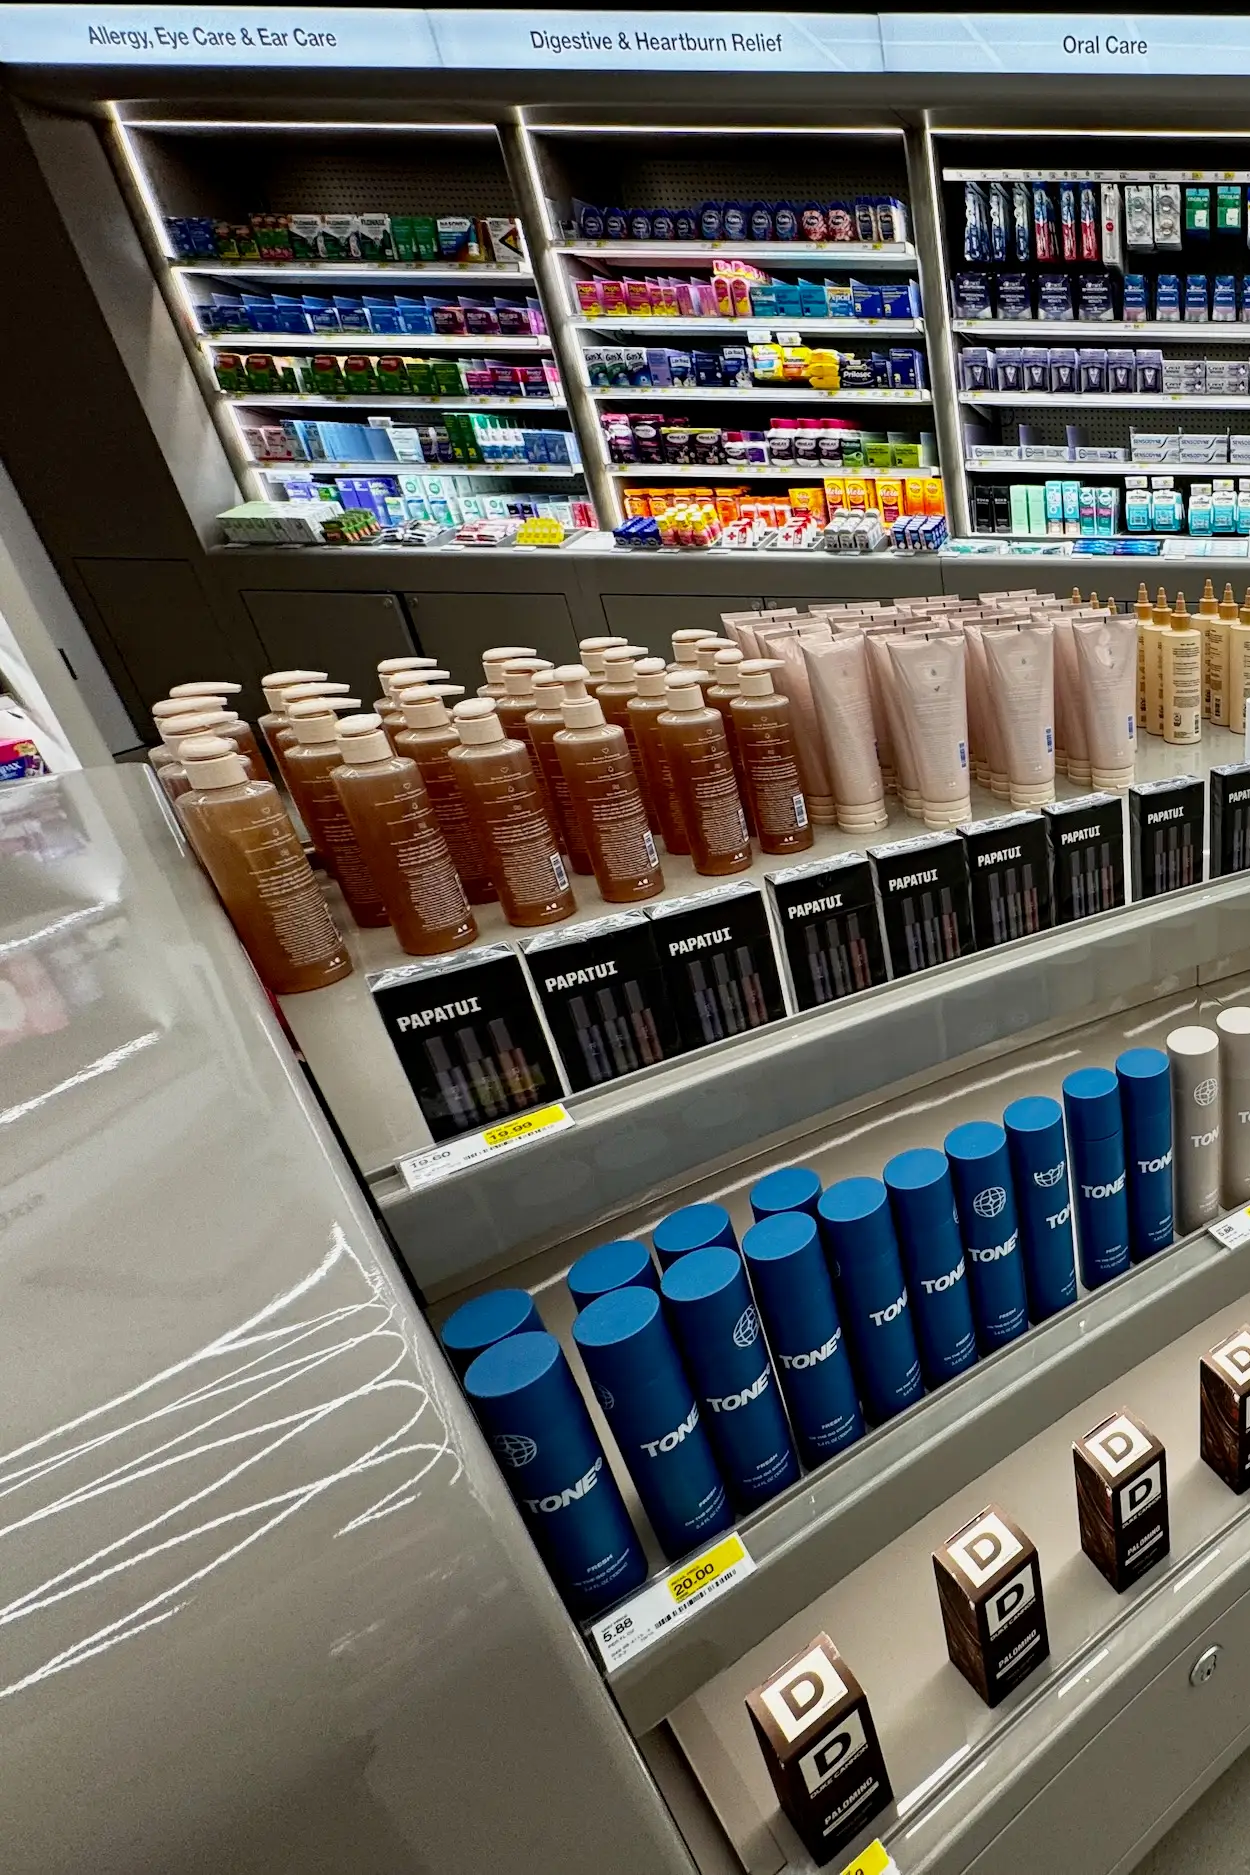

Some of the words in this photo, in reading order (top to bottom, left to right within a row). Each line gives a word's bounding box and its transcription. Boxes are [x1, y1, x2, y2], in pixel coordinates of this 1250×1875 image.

[88, 26, 154, 48] Allergy,
[156, 27, 189, 48] Eye
[192, 27, 237, 46] Care
[241, 28, 254, 46] &
[259, 28, 288, 47] Ear
[293, 29, 337, 47] Care
[530, 30, 613, 54] Digestive
[618, 31, 632, 50] &
[636, 32, 727, 51] Heartburn
[731, 33, 782, 52] Relief
[1063, 35, 1100, 54] Oral
[1105, 35, 1148, 54] Care
[843, 370, 871, 379] Prilosec
[1147, 806, 1185, 824] PAPATUI
[1060, 825, 1101, 845] PAPATUI
[977, 845, 1022, 867] PAPATUI
[888, 868, 939, 892] PAPATUI
[787, 893, 844, 920] PAPATUI
[668, 927, 733, 957] PAPATUI
[544, 960, 618, 993] PAPATUI
[395, 996, 483, 1034] PAPATUI
[489, 1120, 533, 1141] 19.99
[1191, 1127, 1219, 1148] TON
[411, 1150, 452, 1169] 19.60
[1137, 1150, 1173, 1174] TON
[1081, 1172, 1126, 1199] TONE
[967, 1231, 1019, 1263] TONE
[869, 1286, 908, 1327] TON
[779, 1332, 840, 1371] TONE
[706, 1368, 769, 1413] TONE
[640, 1401, 700, 1458] TONE
[821, 1415, 844, 1430] FRESH
[755, 1452, 779, 1471] FRESH
[1098, 1430, 1134, 1464] D
[525, 1462, 600, 1514] TONE
[1128, 1476, 1153, 1513] D
[962, 1531, 1002, 1571] D
[1126, 1524, 1161, 1556] PALOMINO
[586, 1553, 614, 1574] FRESH
[673, 1562, 715, 1597] 20.00
[995, 1582, 1025, 1622] D
[1007, 1597, 1037, 1626] CANNON
[603, 1617, 633, 1643] 5.88
[997, 1628, 1037, 1669] PALOMINO
[778, 1669, 825, 1722] D
[812, 1730, 852, 1780] D
[833, 1743, 869, 1777] CANNON
[823, 1776, 874, 1826] PALOMINO
